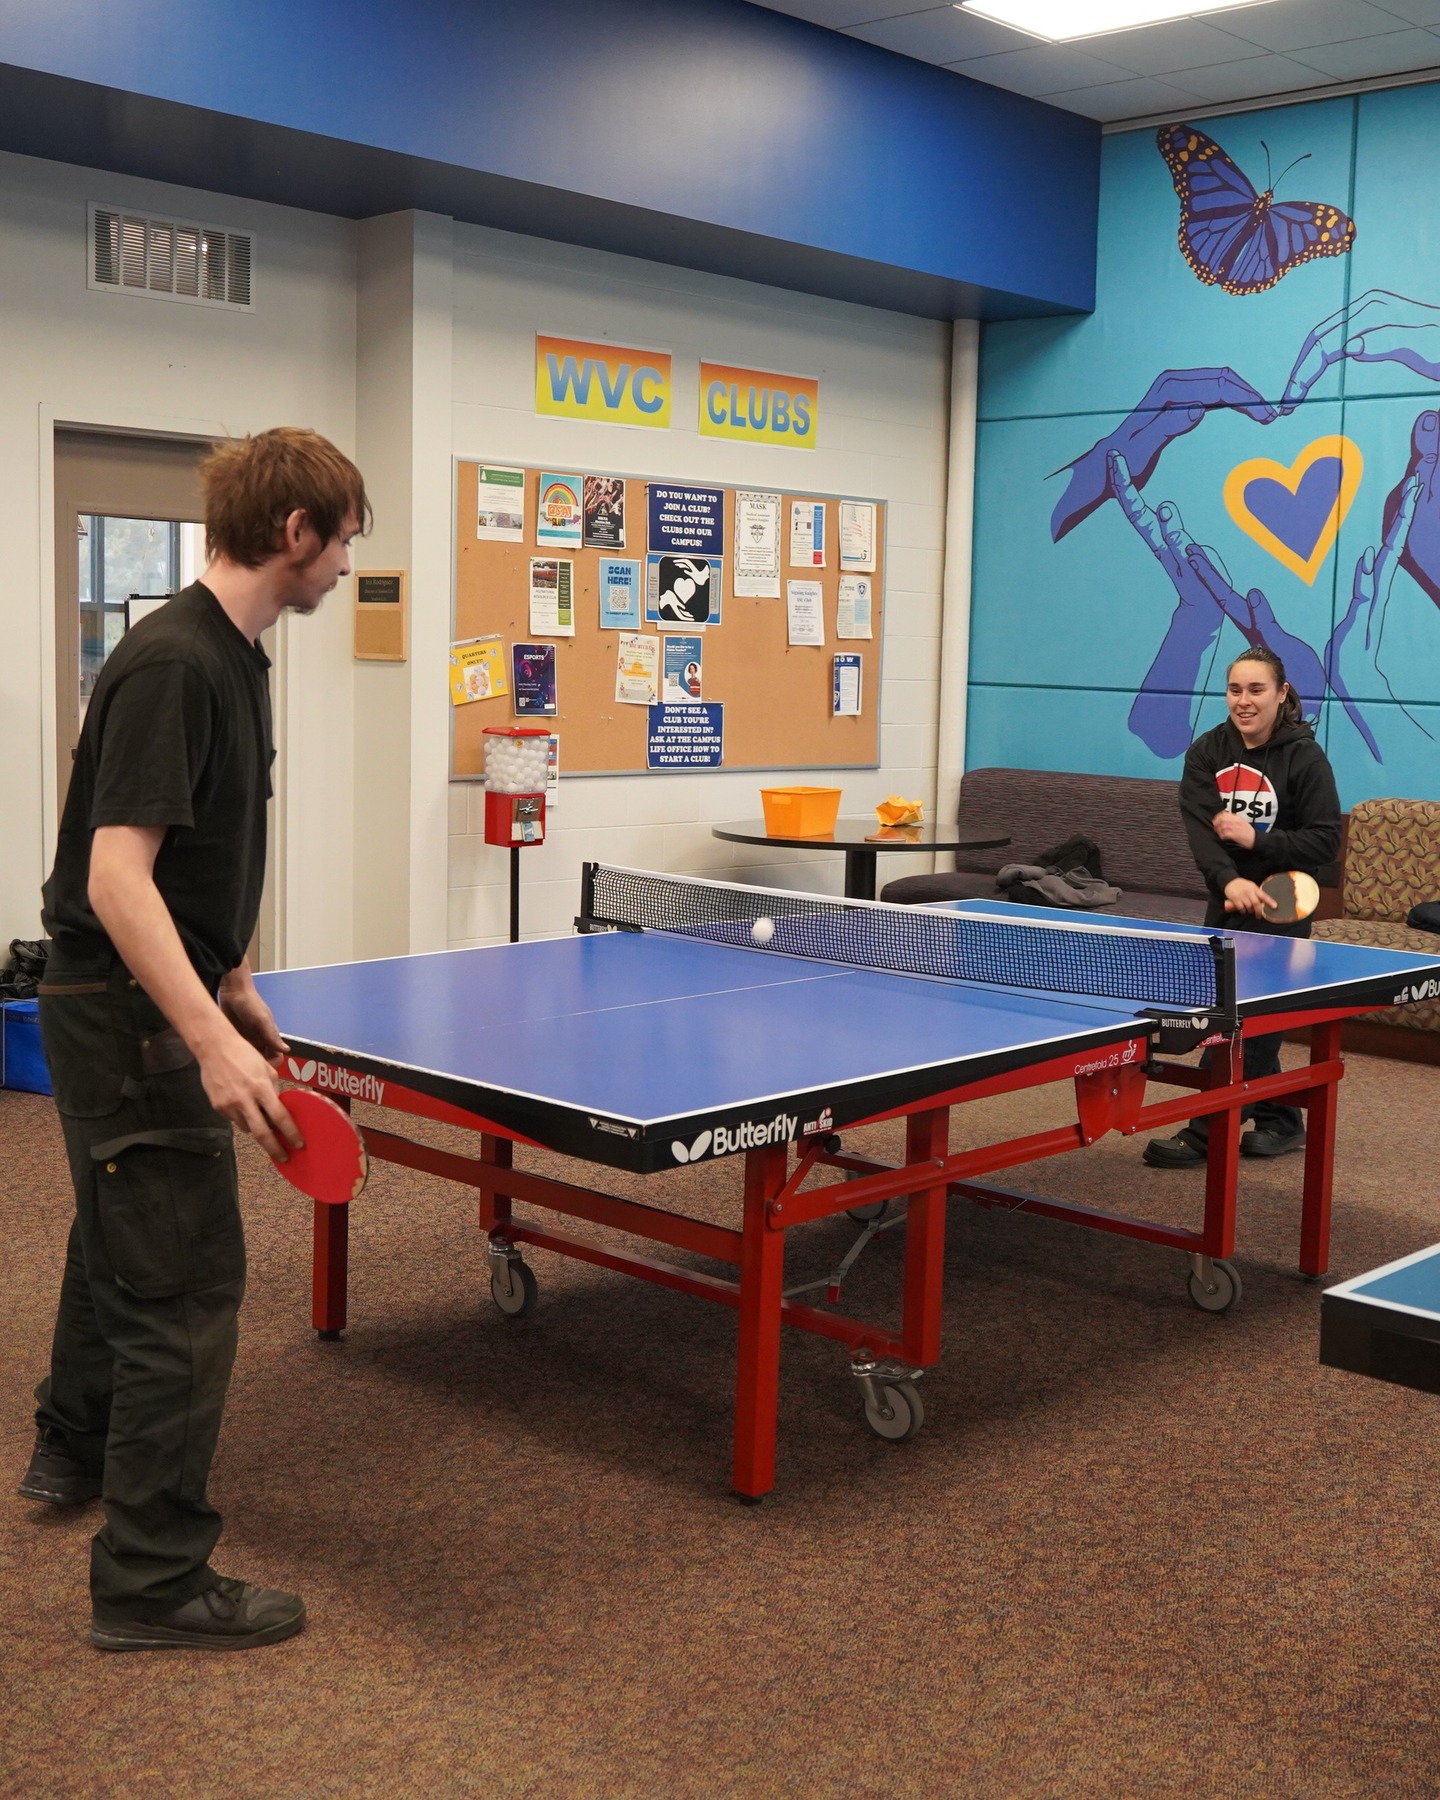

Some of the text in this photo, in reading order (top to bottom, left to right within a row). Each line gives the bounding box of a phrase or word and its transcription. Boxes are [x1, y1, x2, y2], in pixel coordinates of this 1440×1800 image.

[545, 352, 811, 436] WVC CLUBS
[656, 490, 717, 503] DO YOU WANT TO
[664, 503, 681, 511] JOIN
[688, 505, 711, 513] CLUB?
[750, 502, 767, 510] MASK
[549, 505, 571, 518] QSA
[659, 514, 715, 525] CHECK OUT THE
[661, 525, 712, 536] CLUBS ON OUR
[671, 538, 702, 547] CAMPUS!
[608, 566, 631, 575] SCAN
[607, 576, 632, 585] HERE!
[462, 650, 487, 659] QUARTERS
[665, 706, 687, 714] DON'T
[663, 716, 682, 724] CLUB
[650, 745, 666, 753] LIFE
[659, 755, 711, 763] START A CLUB!
[1161, 1018, 1191, 1029] BUTTERFLY
[1074, 1054, 1119, 1075] Centrefold 25
[317, 1061, 385, 1105] Butterfly
[803, 1121, 817, 1133] ANTI
[713, 1113, 798, 1155] Butterfly
